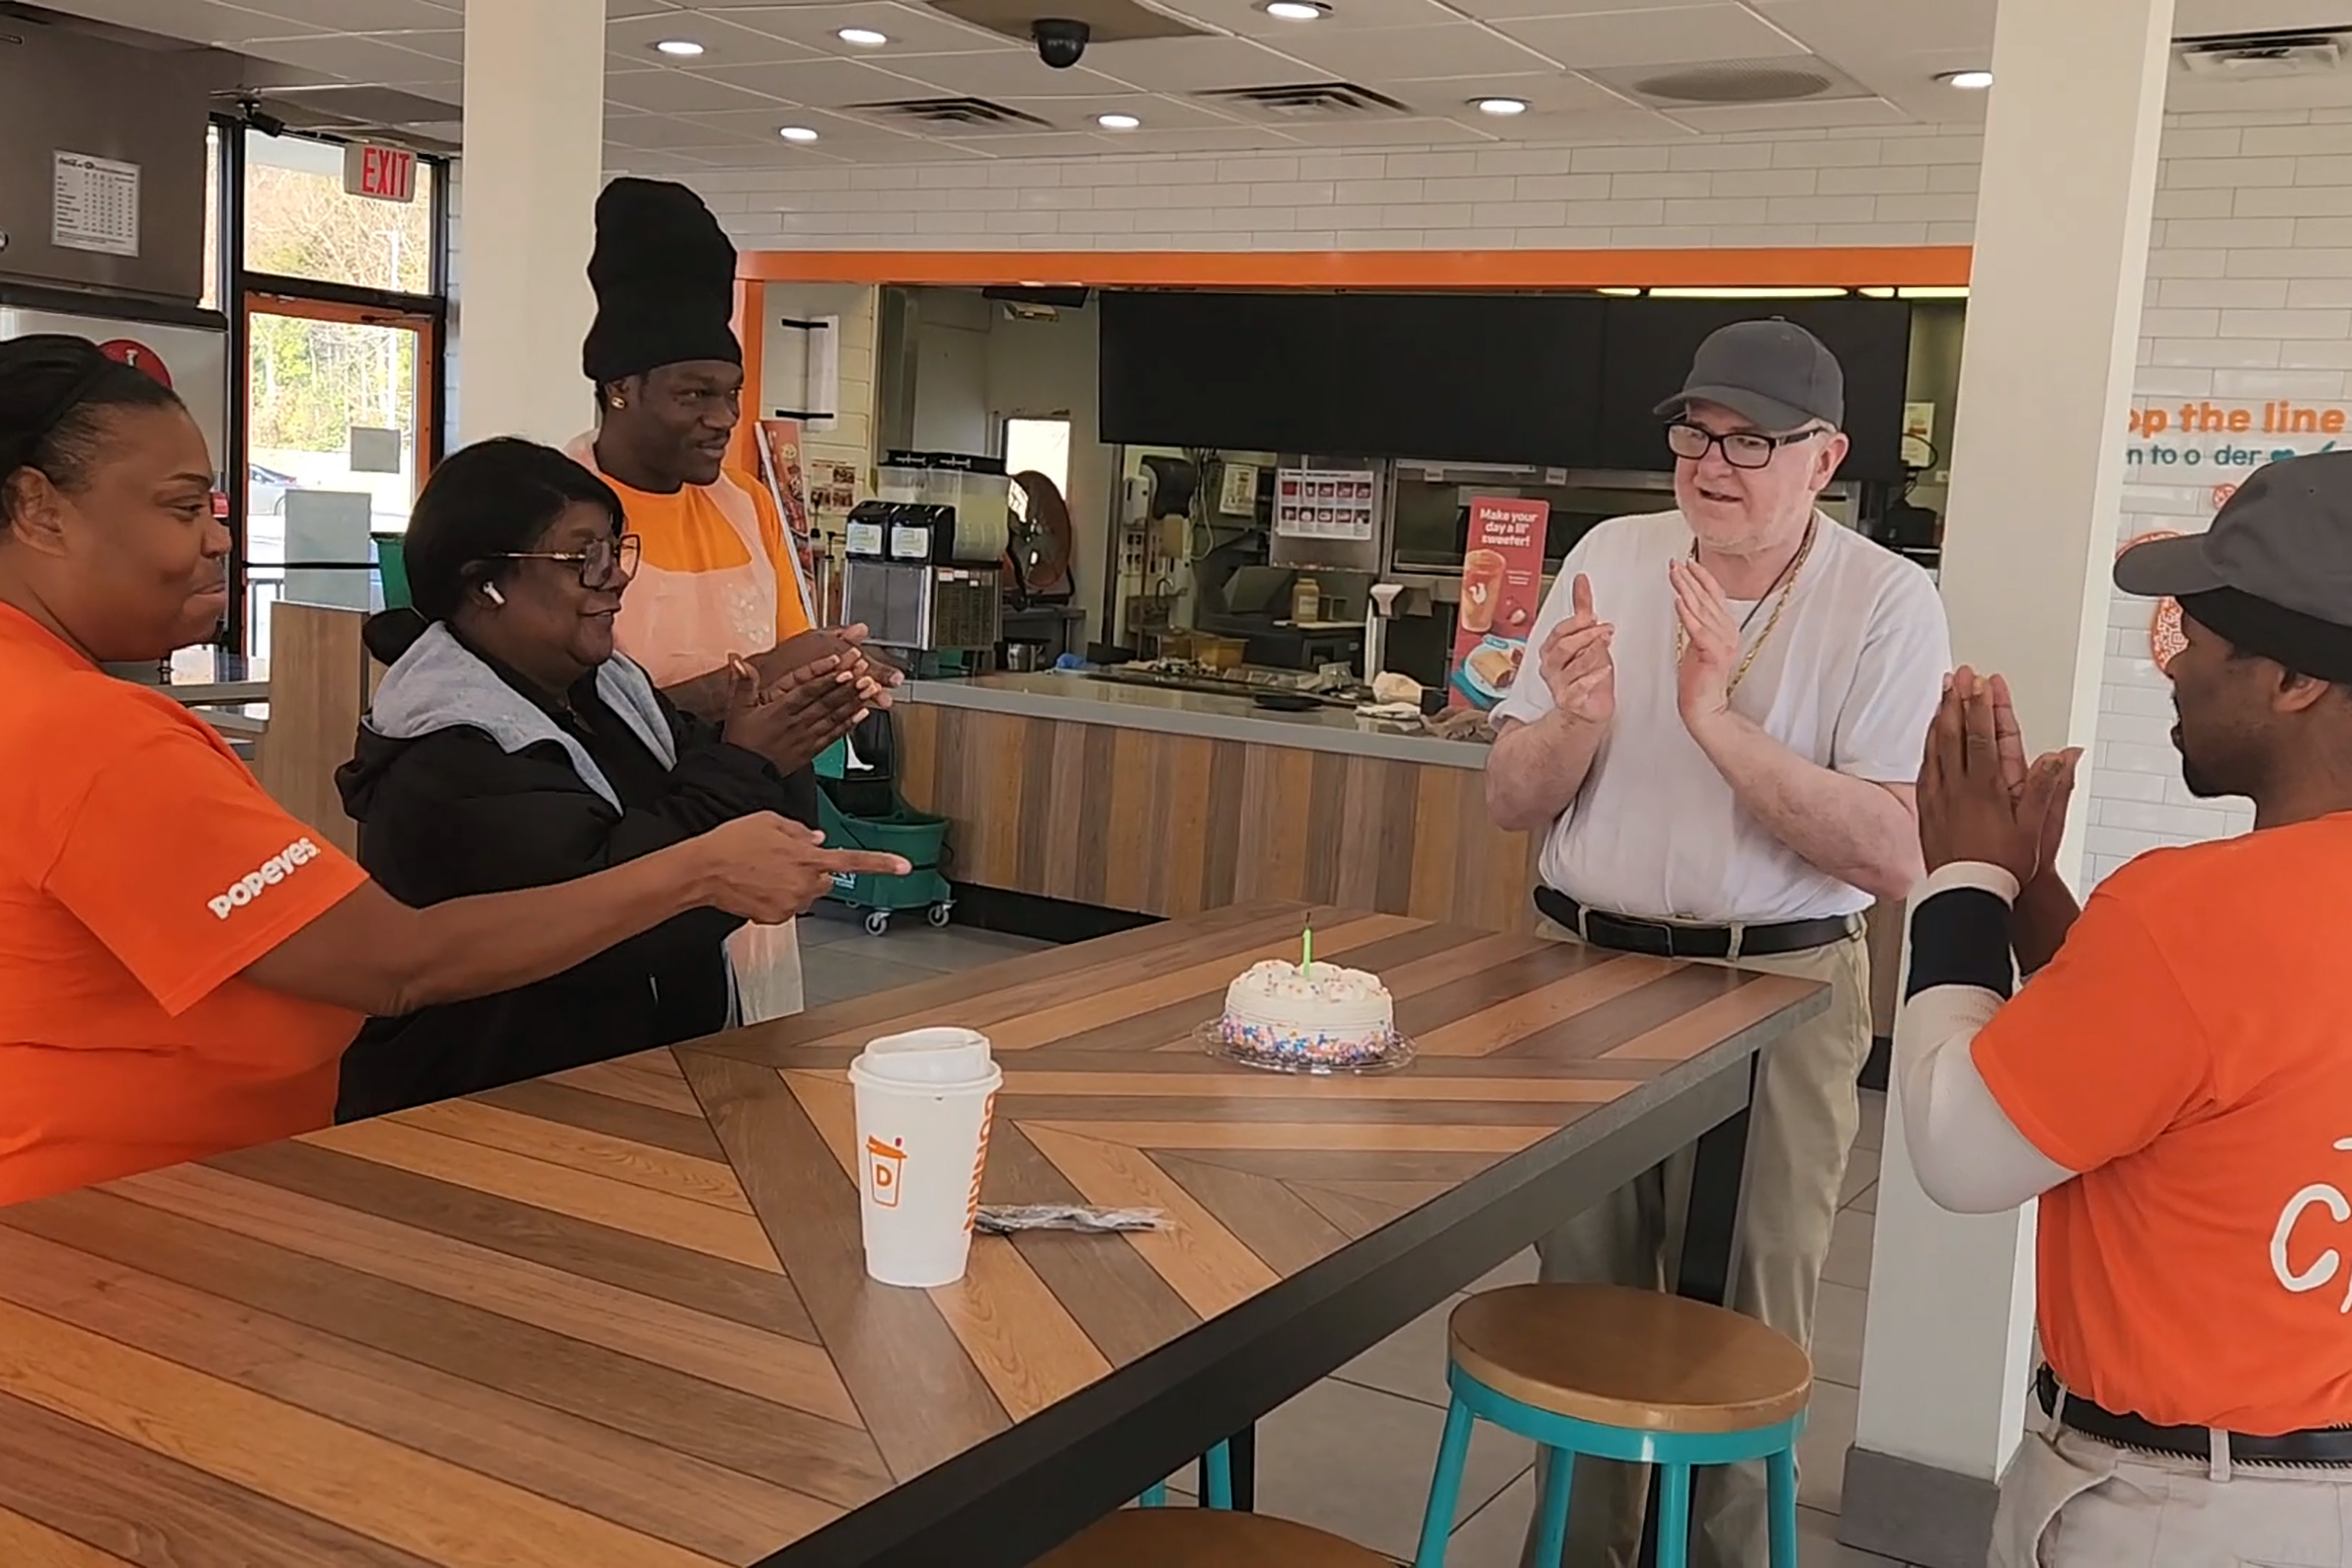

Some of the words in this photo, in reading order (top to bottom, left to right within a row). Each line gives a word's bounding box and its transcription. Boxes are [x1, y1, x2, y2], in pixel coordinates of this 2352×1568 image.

[363, 147, 411, 198] EXIT
[2179, 401, 2252, 433] the
[2262, 399, 2346, 434] line
[2151, 444, 2179, 466] to
[2183, 444, 2263, 466] oder
[1479, 508, 1510, 521] Make
[1511, 512, 1539, 523] your
[1485, 521, 1506, 535] day
[1506, 524, 1514, 533] a
[1481, 534, 1531, 547] sweeter!
[876, 1163, 893, 1187] D
